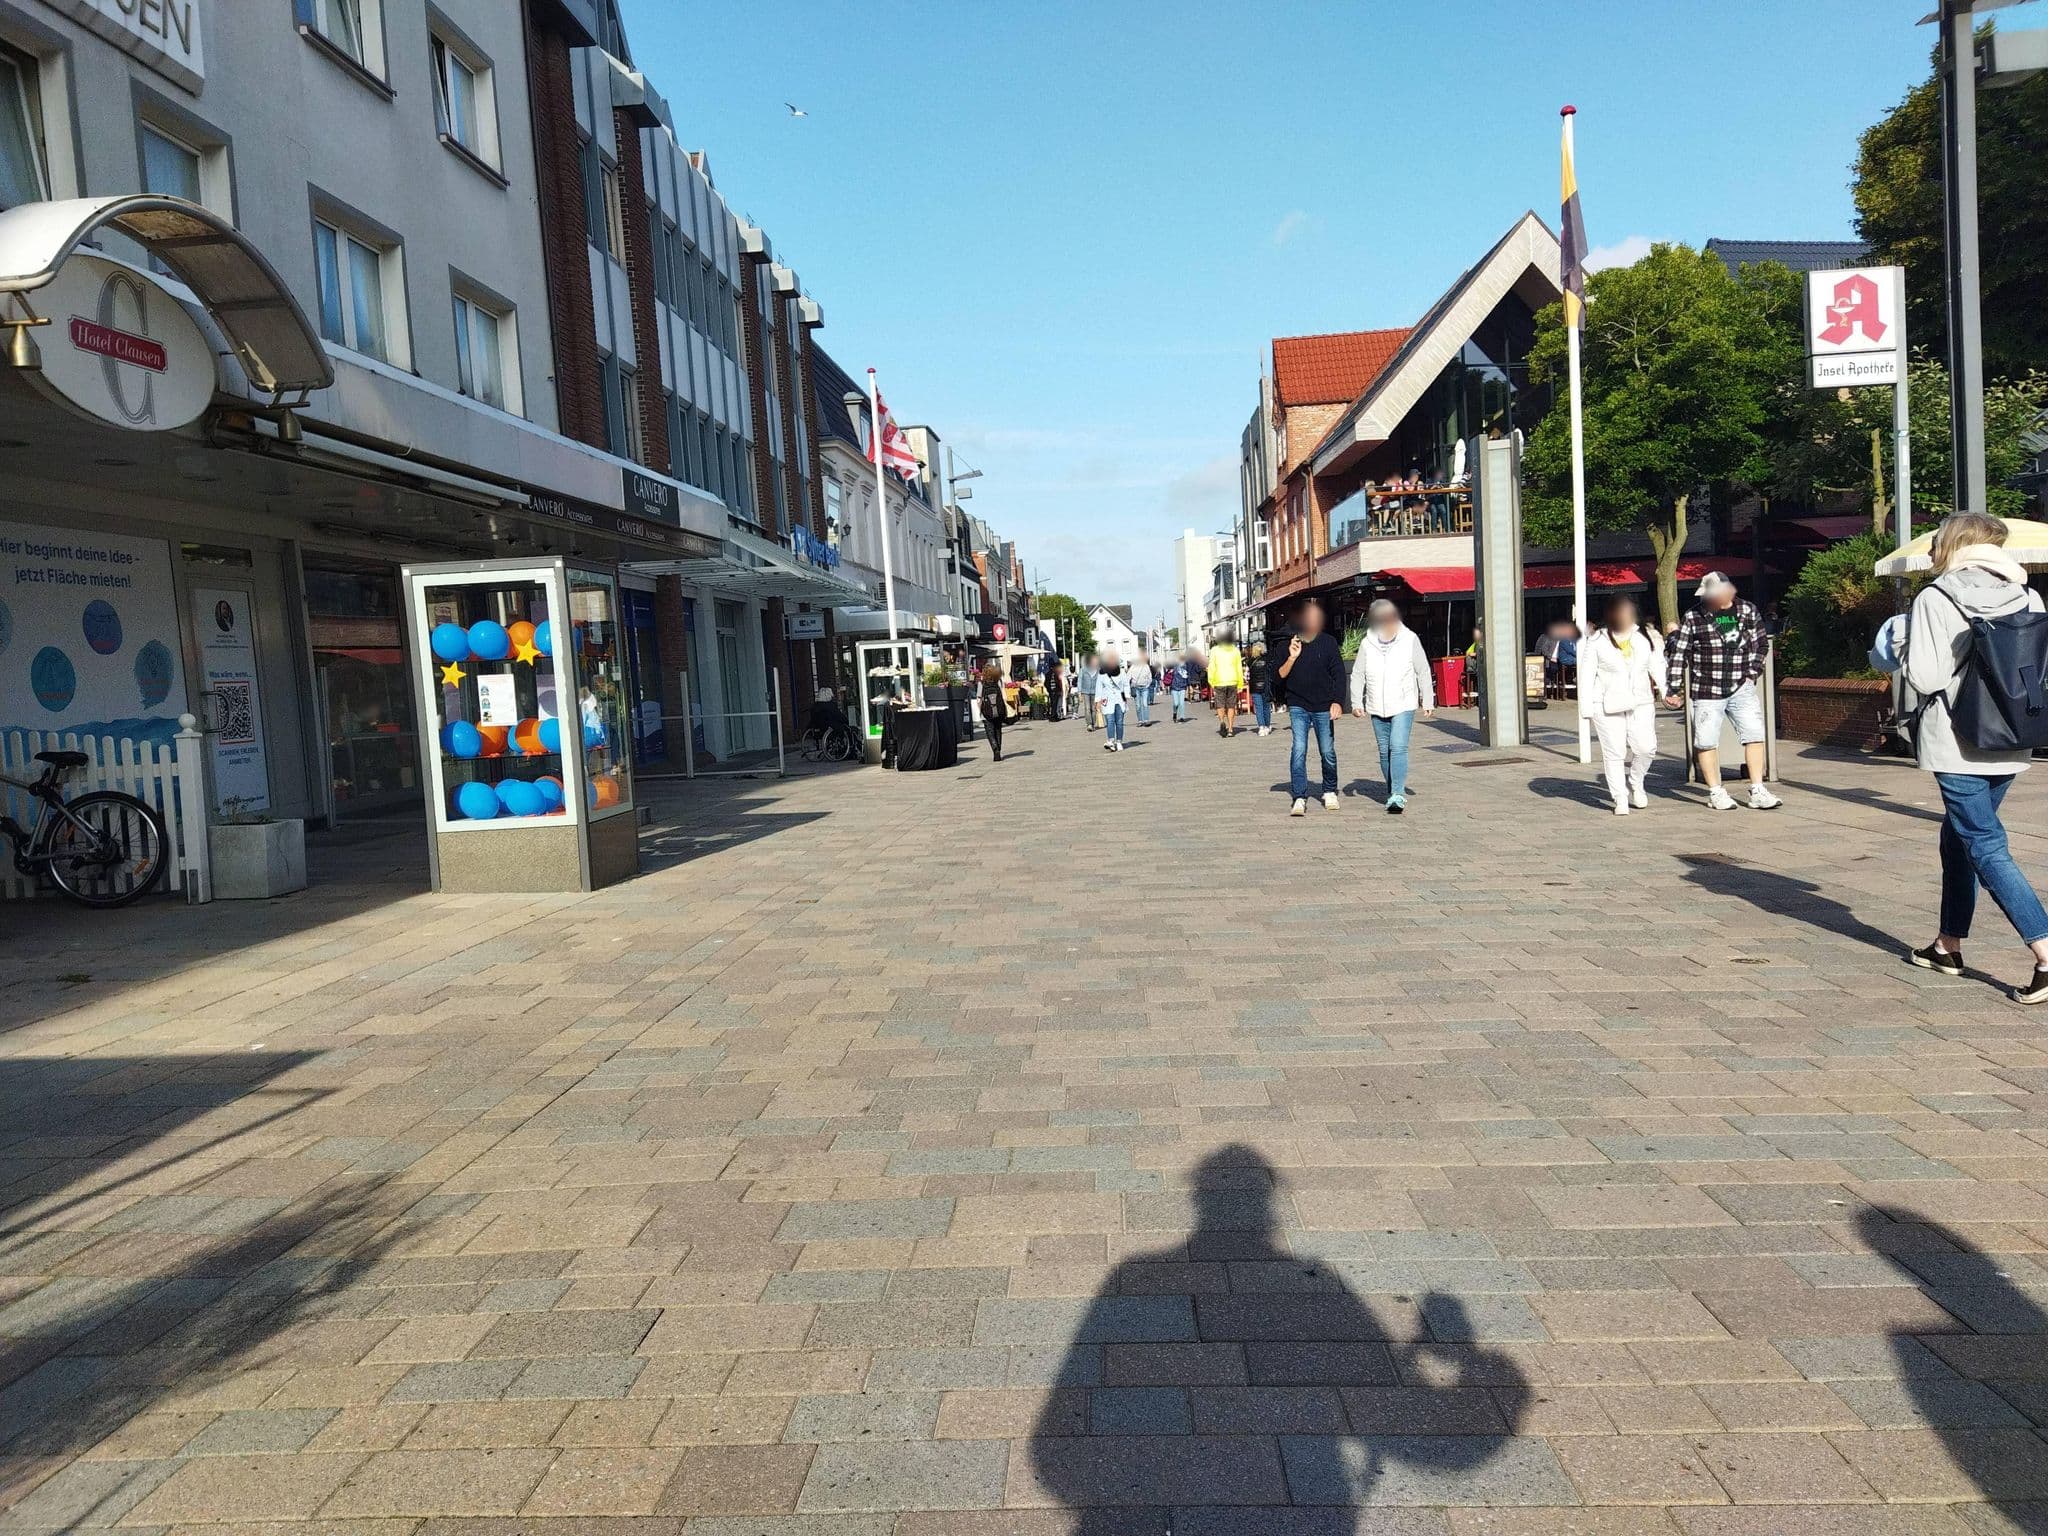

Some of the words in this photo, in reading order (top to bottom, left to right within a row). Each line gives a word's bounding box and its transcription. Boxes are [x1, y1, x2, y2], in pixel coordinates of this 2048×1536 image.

[78, 325, 111, 351] Hotel
[115, 337, 161, 366] Clausen
[1817, 363, 1845, 377] Insel
[1847, 361, 1894, 377] Apotheke
[633, 475, 668, 506] CANVERO
[528, 494, 564, 517] CANVERO
[616, 518, 644, 537] CANVERO
[25, 541, 75, 560] beginnt
[75, 547, 107, 562] deine
[109, 550, 133, 564] Idee
[15, 566, 45, 584] jetzt
[47, 568, 87, 585] Fläche
[89, 572, 131, 588] mieten!
